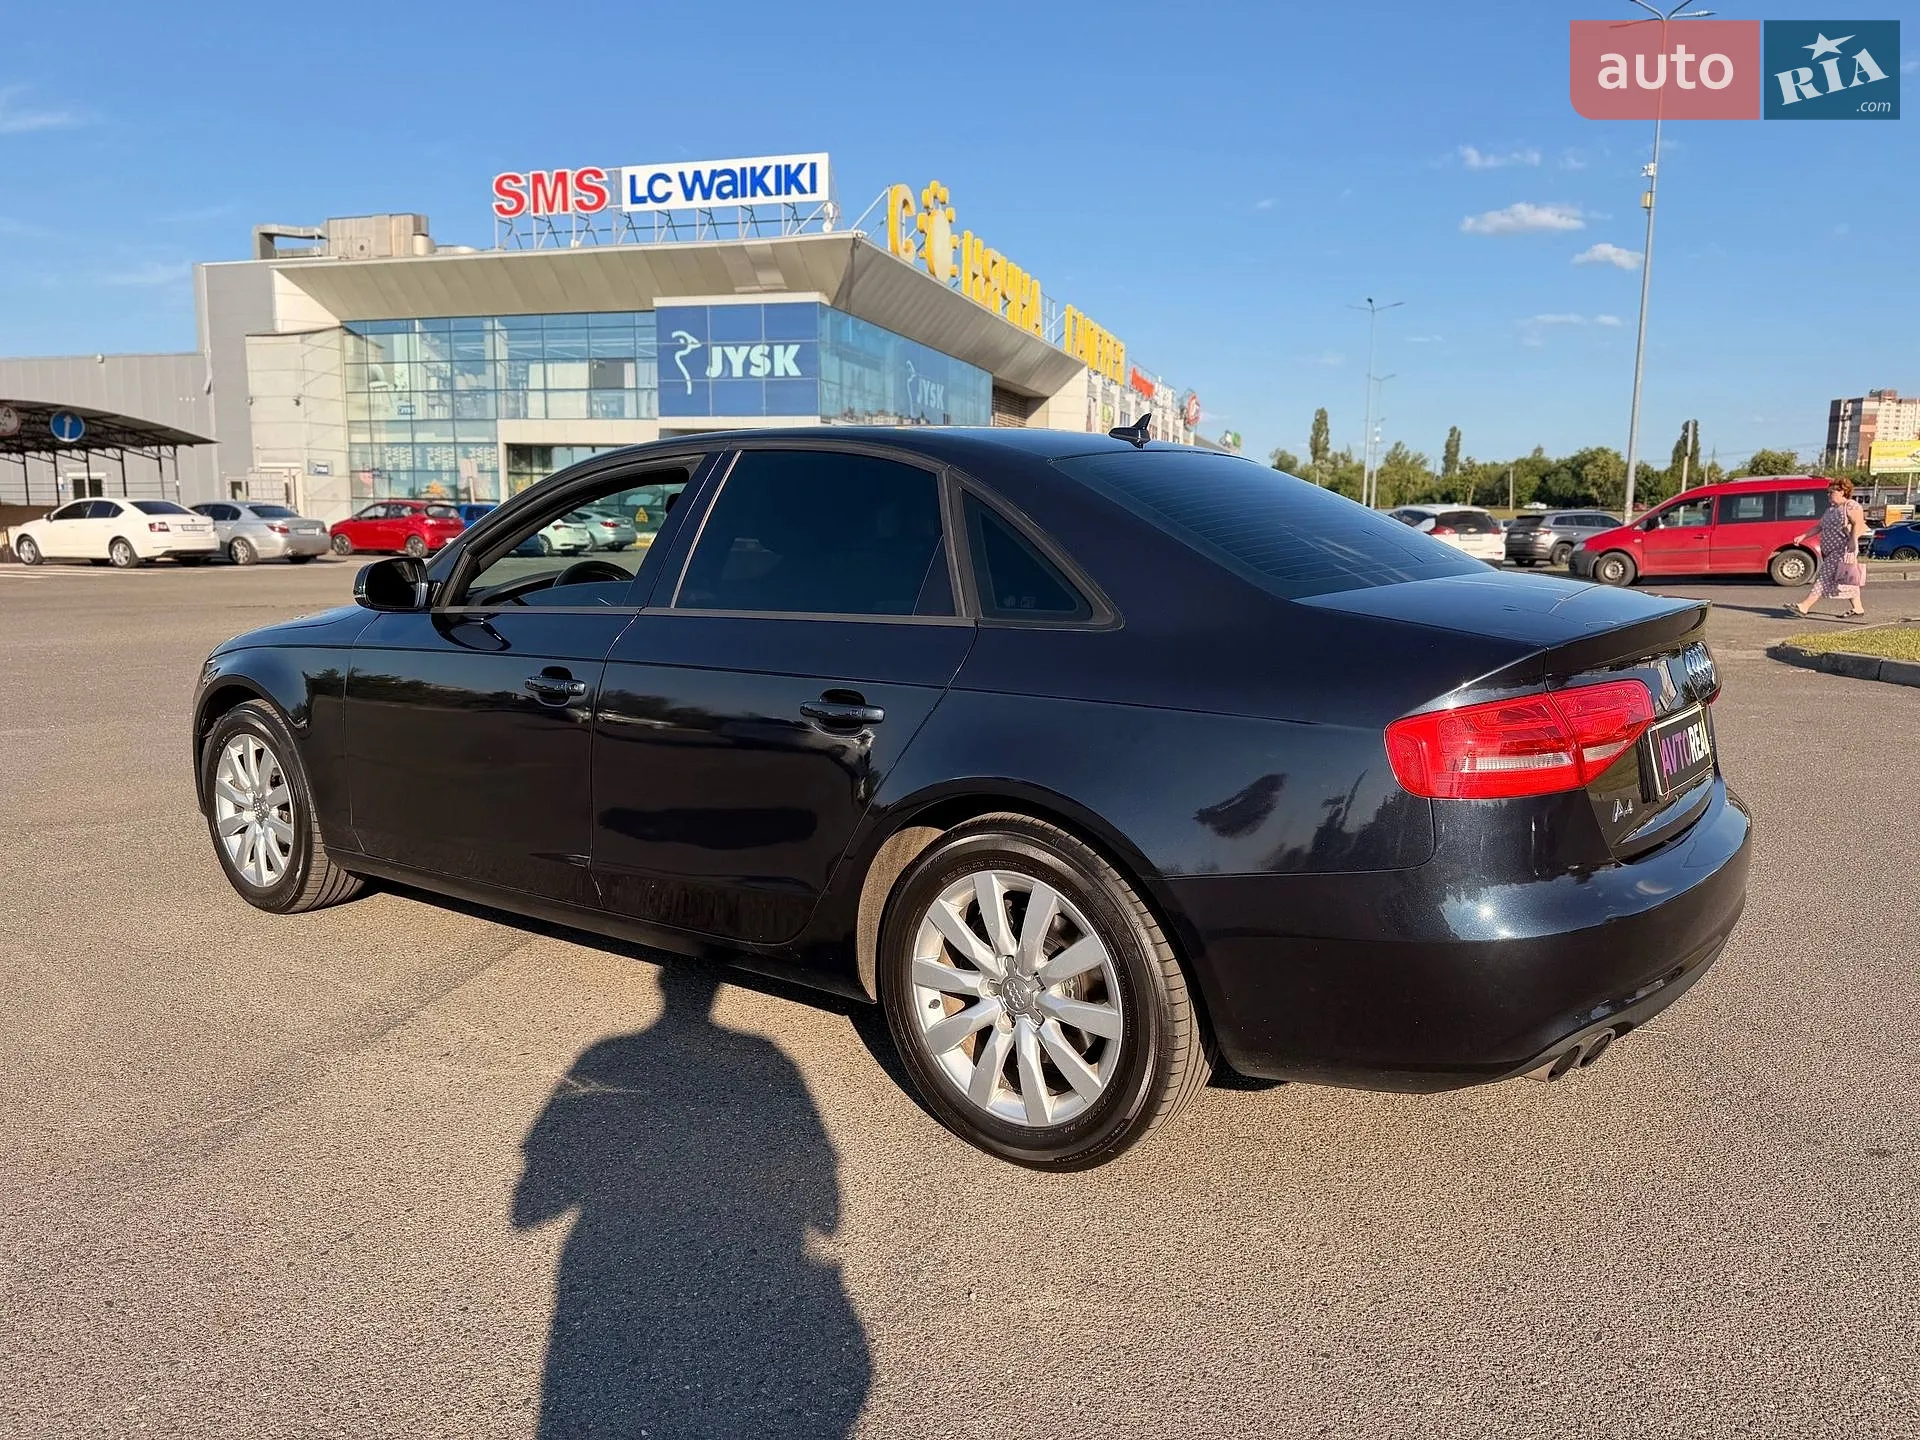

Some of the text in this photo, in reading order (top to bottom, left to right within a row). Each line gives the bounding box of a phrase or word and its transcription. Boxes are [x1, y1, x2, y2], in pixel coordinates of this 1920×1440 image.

[493, 168, 609, 216] SMS
[629, 172, 673, 205] LC
[705, 344, 802, 378] JYSK
[917, 377, 945, 411] JYSK
